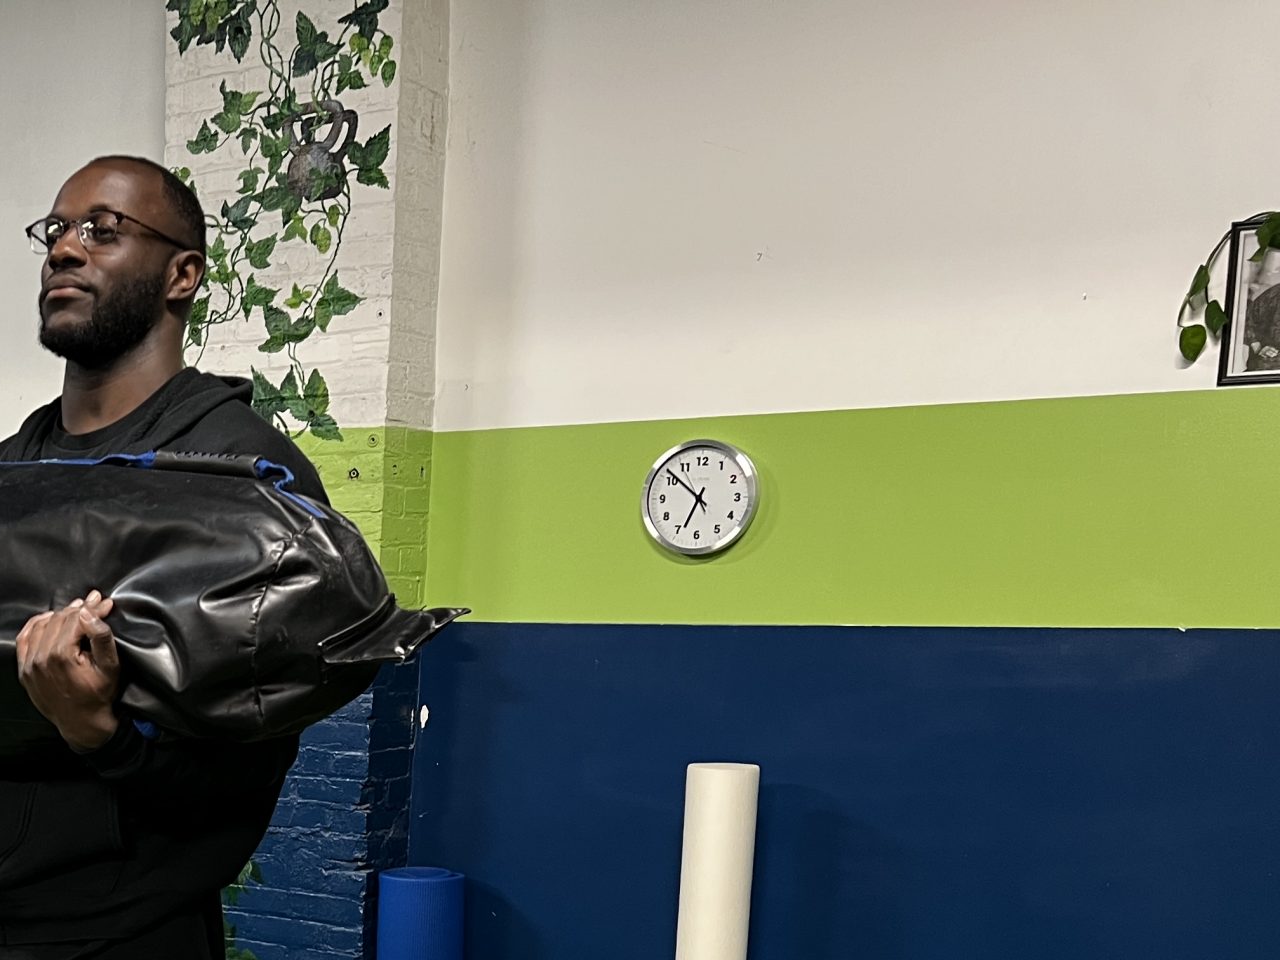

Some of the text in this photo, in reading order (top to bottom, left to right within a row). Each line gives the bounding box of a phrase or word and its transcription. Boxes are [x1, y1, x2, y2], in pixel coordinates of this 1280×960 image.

[696, 456, 709, 466] 12
[680, 462, 690, 472] 11
[666, 476, 678, 486] 10
